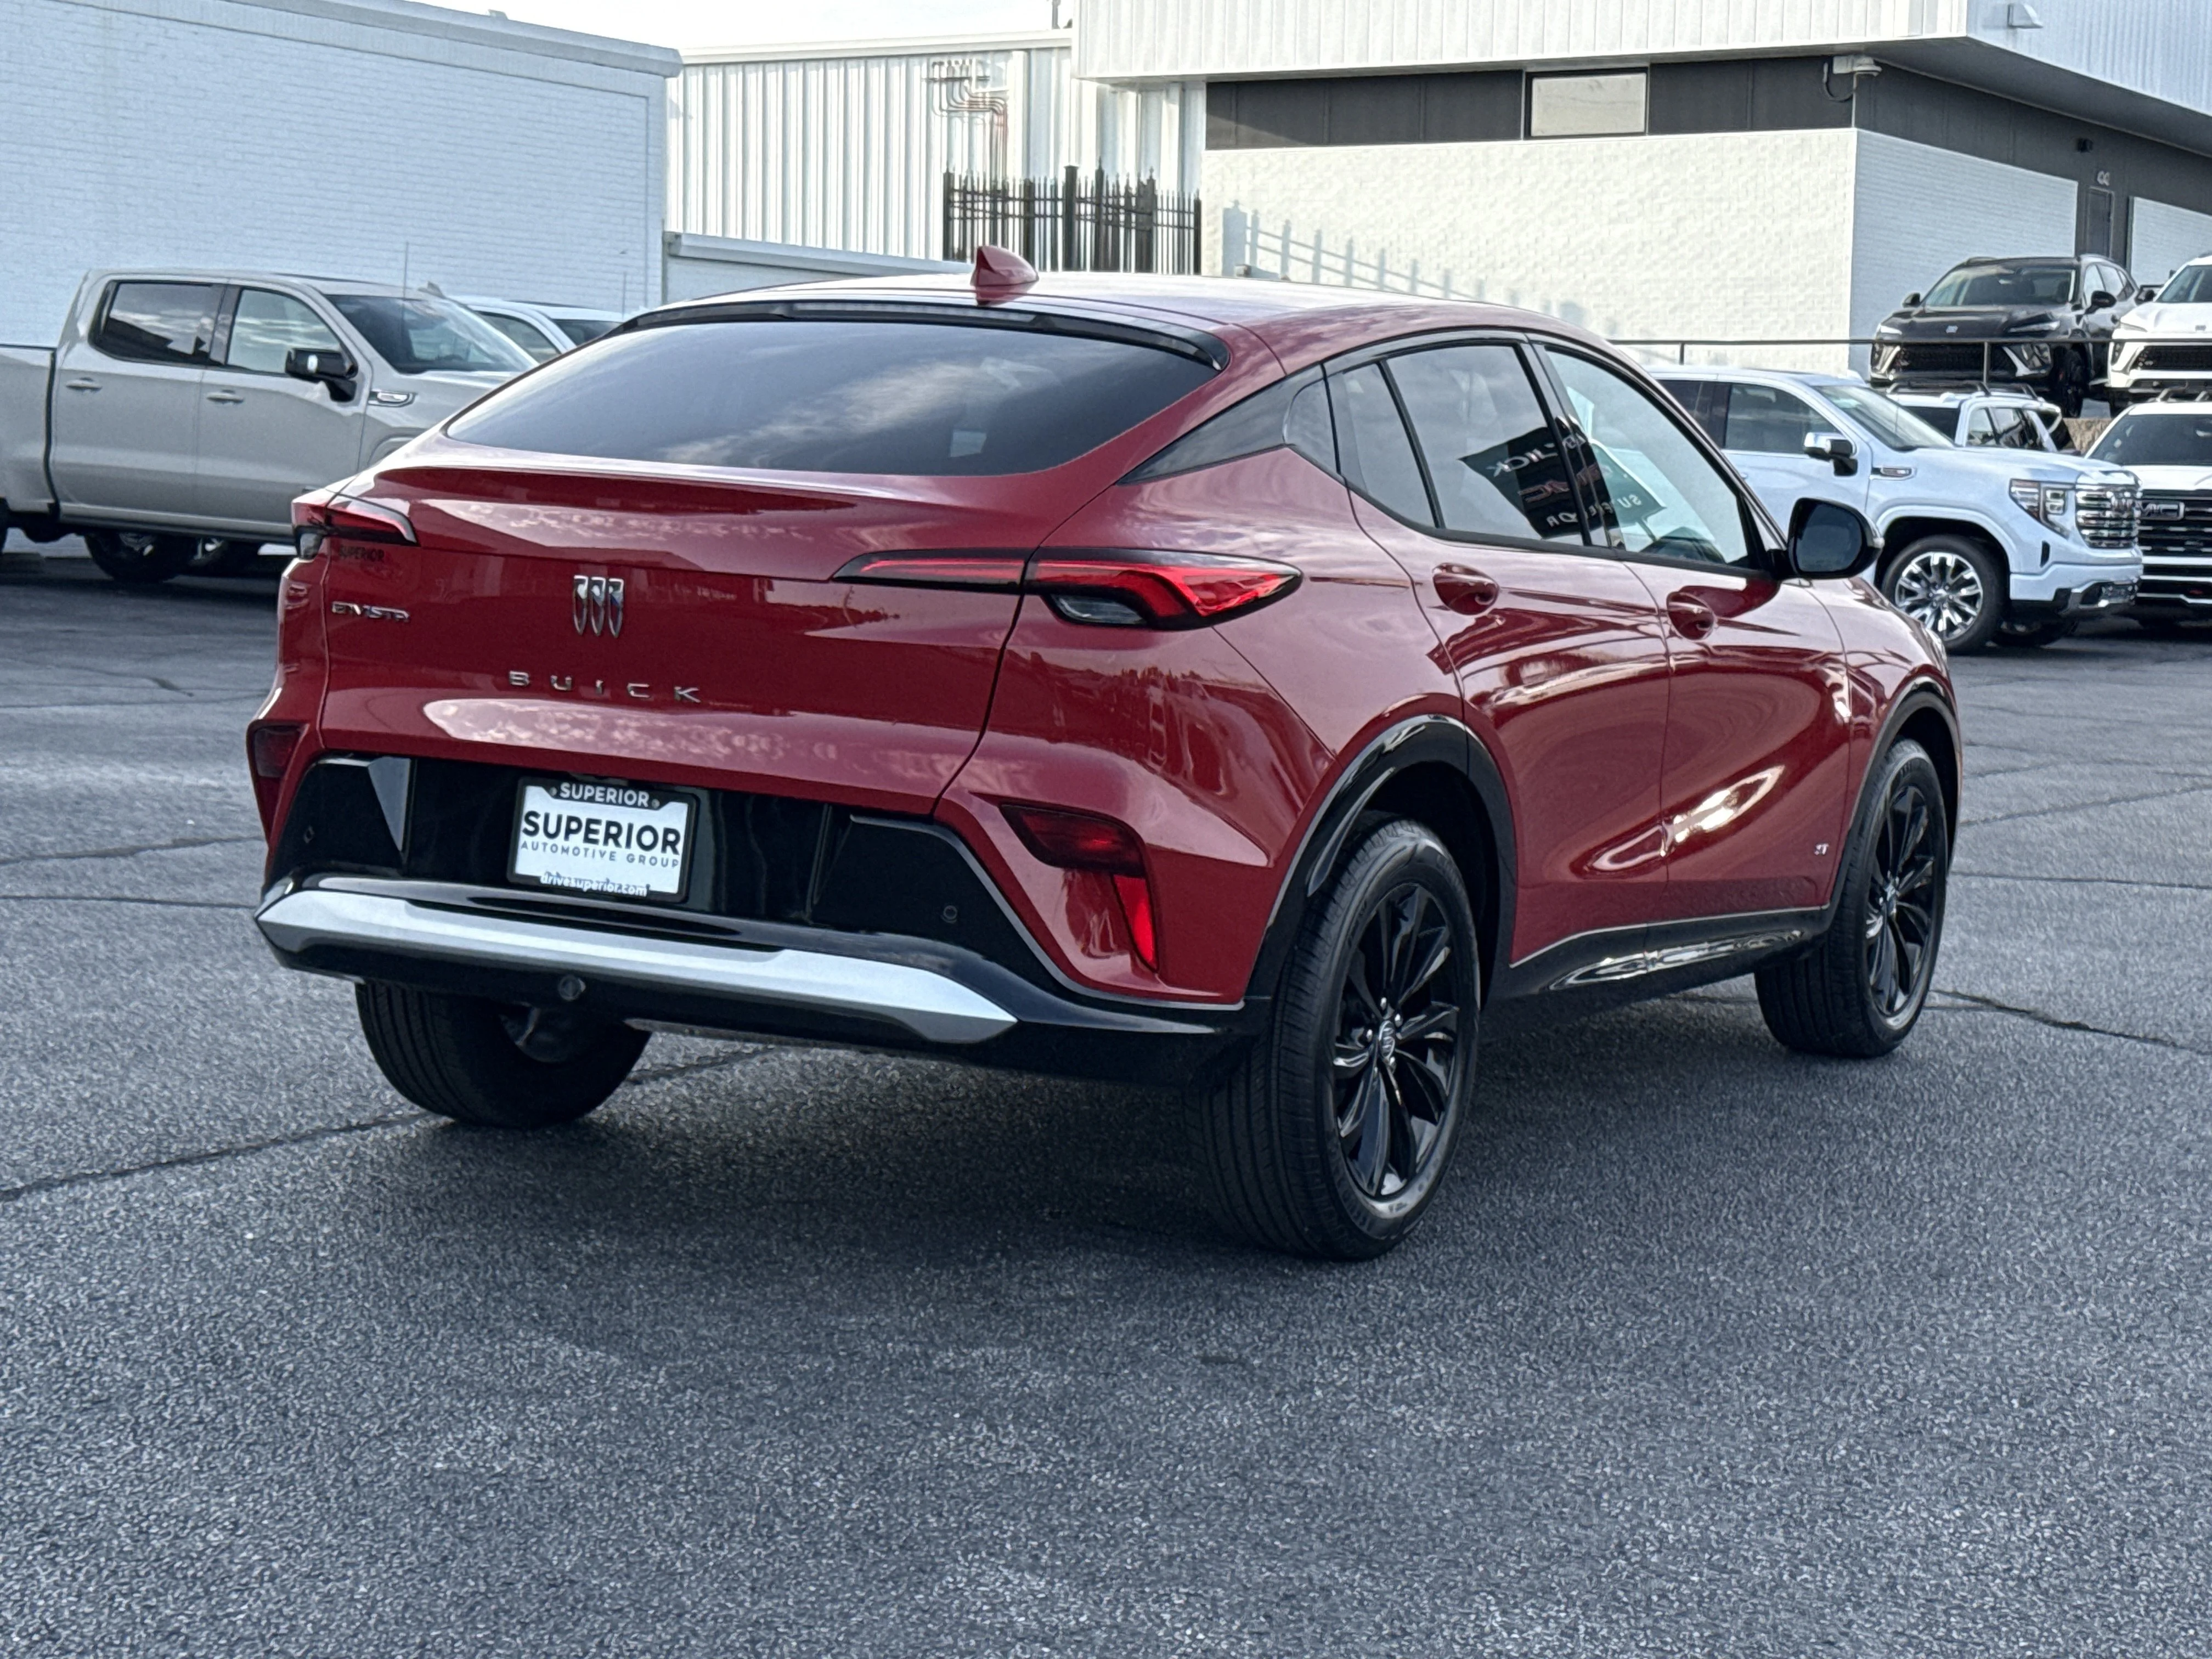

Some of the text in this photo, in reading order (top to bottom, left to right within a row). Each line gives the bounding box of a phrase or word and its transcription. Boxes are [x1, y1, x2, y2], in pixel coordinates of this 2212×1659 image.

[508, 670, 702, 703] BUICK
[560, 782, 650, 808] SUPERIOR
[522, 810, 681, 856] SUPERIOR
[521, 840, 680, 868] AUTOMOTIVE GROUP
[540, 871, 648, 897] drivesuperior.com
